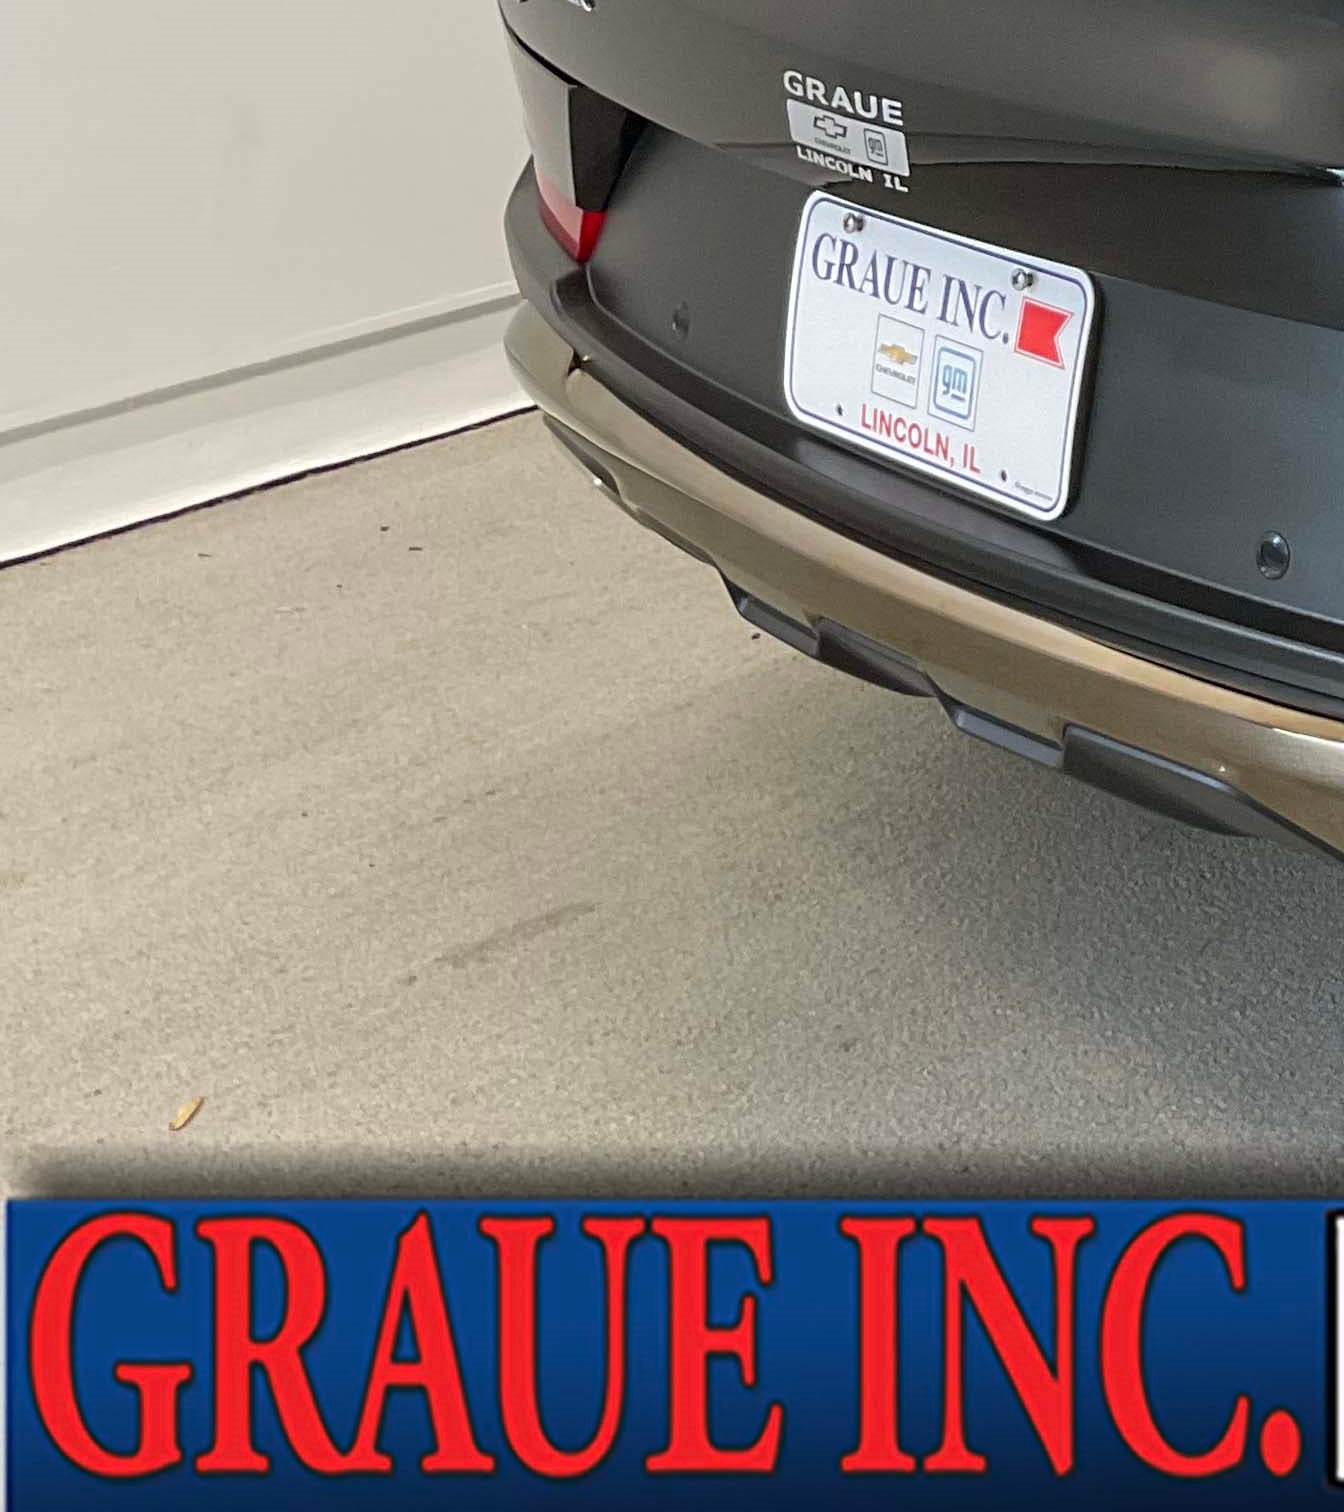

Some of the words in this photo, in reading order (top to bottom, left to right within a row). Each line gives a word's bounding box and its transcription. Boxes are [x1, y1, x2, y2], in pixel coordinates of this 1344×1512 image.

[783, 70, 904, 126] GRAUE
[797, 145, 873, 182] LINCOLN
[883, 173, 909, 192] IL
[811, 232, 932, 315] GRAUE
[935, 273, 1010, 344] INC.
[861, 403, 955, 468] LINCOLN,
[962, 443, 981, 474] IL
